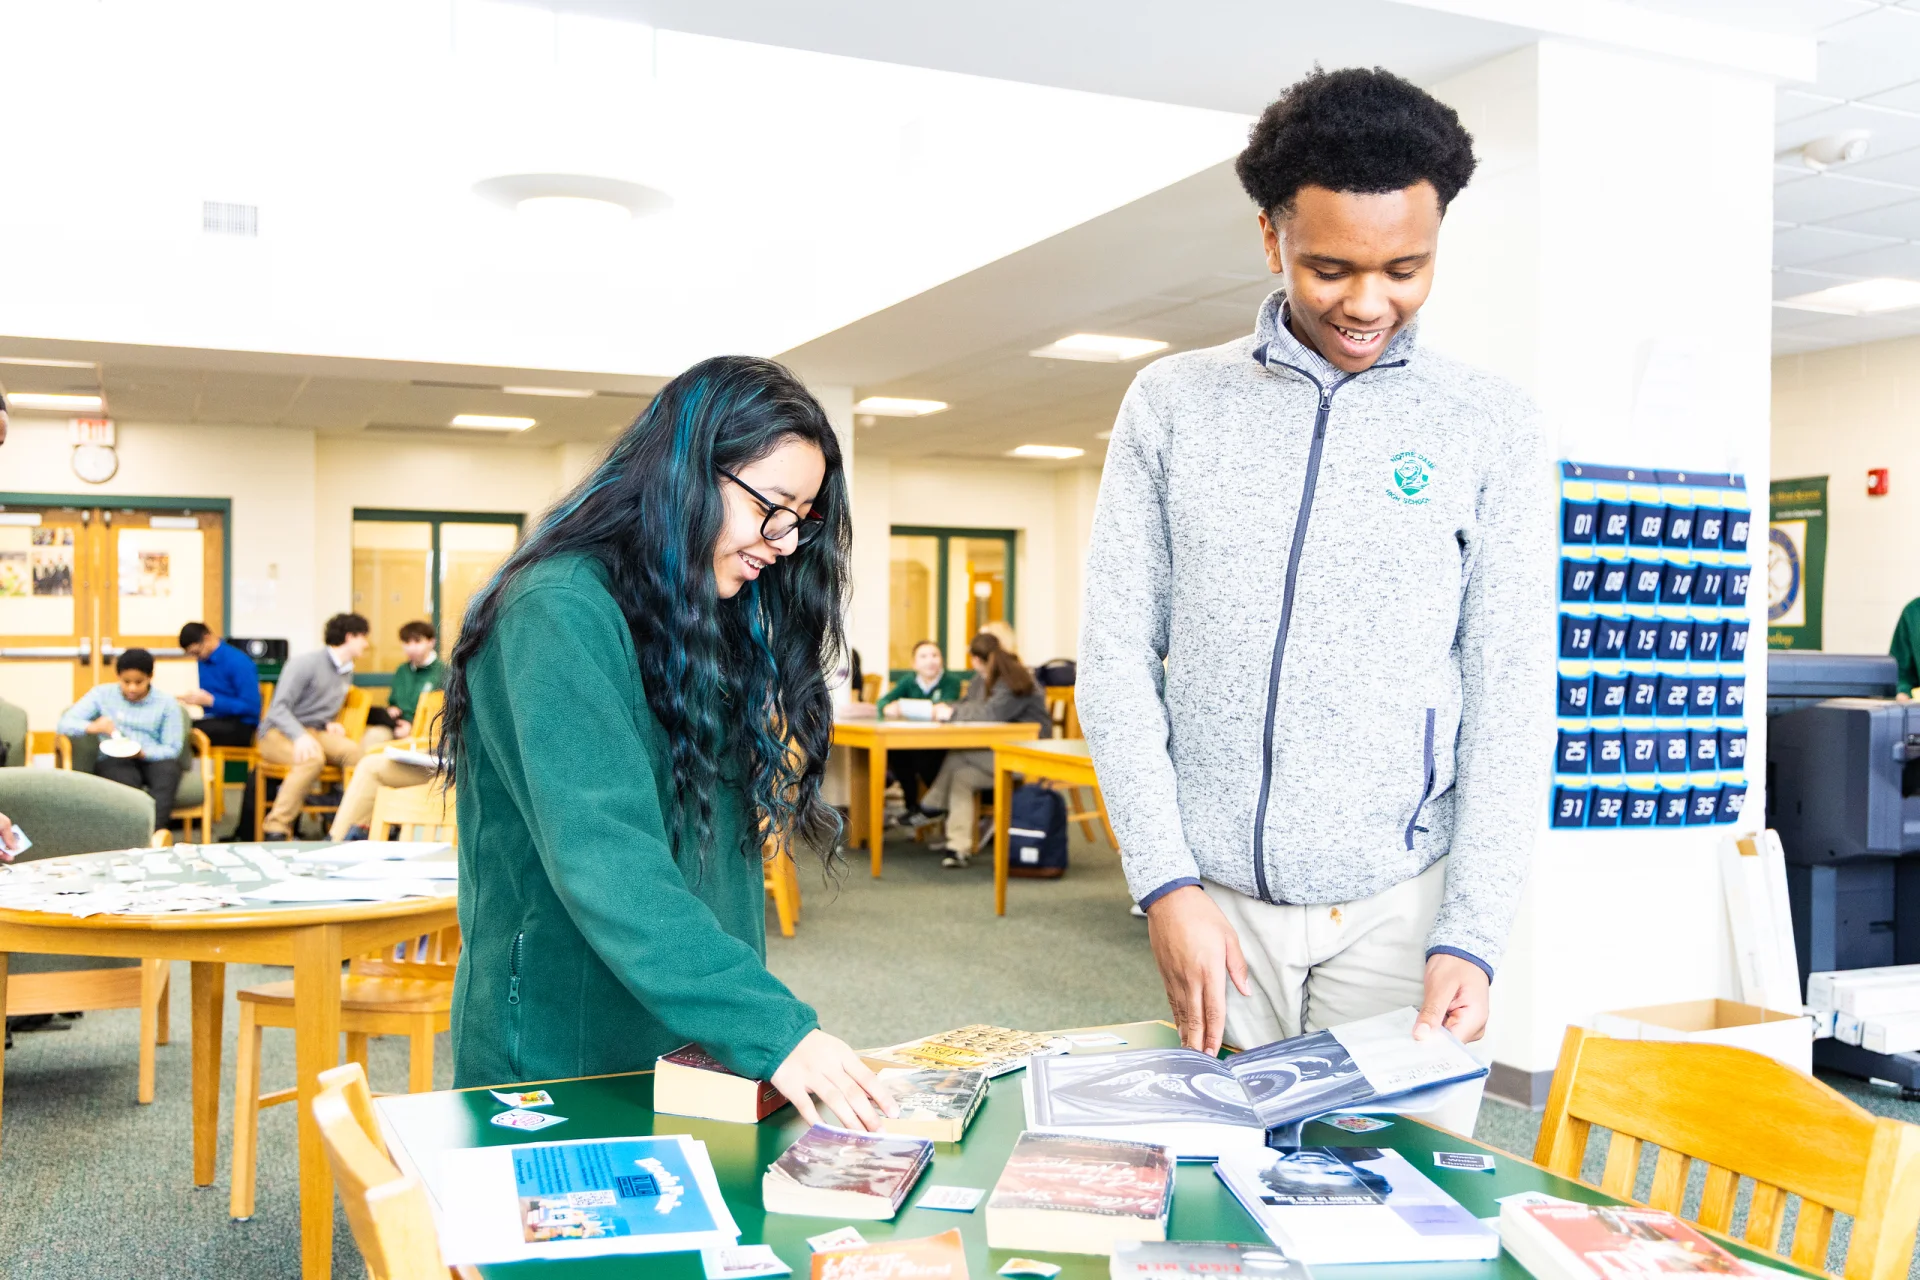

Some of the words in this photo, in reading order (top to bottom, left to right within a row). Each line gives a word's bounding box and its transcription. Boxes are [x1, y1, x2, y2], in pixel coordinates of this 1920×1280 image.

[1390, 451, 1415, 463] NOTRE
[1574, 514, 1592, 534] 01
[1607, 515, 1627, 535] 02
[1641, 517, 1661, 536] 03
[1672, 519, 1691, 538] 04
[1702, 520, 1721, 539] 05
[1732, 521, 1748, 541] 06
[1573, 571, 1594, 590] 07
[1605, 572, 1625, 591] 08
[1638, 571, 1659, 591] 09
[1673, 575, 1691, 594] 10
[1705, 575, 1720, 593] 11
[1733, 575, 1749, 594] 12
[1573, 629, 1591, 648] 13
[1608, 630, 1624, 648] 14
[1638, 630, 1656, 649] 15
[1670, 631, 1688, 650] 16
[1701, 632, 1718, 650] 17
[1732, 631, 1747, 650] 18
[1571, 687, 1587, 706] 19
[1605, 686, 1624, 705] 20
[1636, 685, 1654, 703] 21
[1668, 686, 1687, 705] 22
[1697, 686, 1716, 705] 23
[1726, 686, 1744, 705] 24
[1566, 741, 1586, 760] 25
[1602, 740, 1620, 760] 26
[1635, 740, 1654, 759] 27
[1668, 739, 1686, 759] 28
[1698, 740, 1716, 759] 29
[1728, 738, 1745, 757] 30
[1561, 799, 1582, 817] 31
[1598, 799, 1621, 817] 32
[1632, 800, 1655, 818] 33
[1667, 799, 1686, 817] 34
[1695, 797, 1715, 815] 35
[1725, 794, 1744, 812] 36
